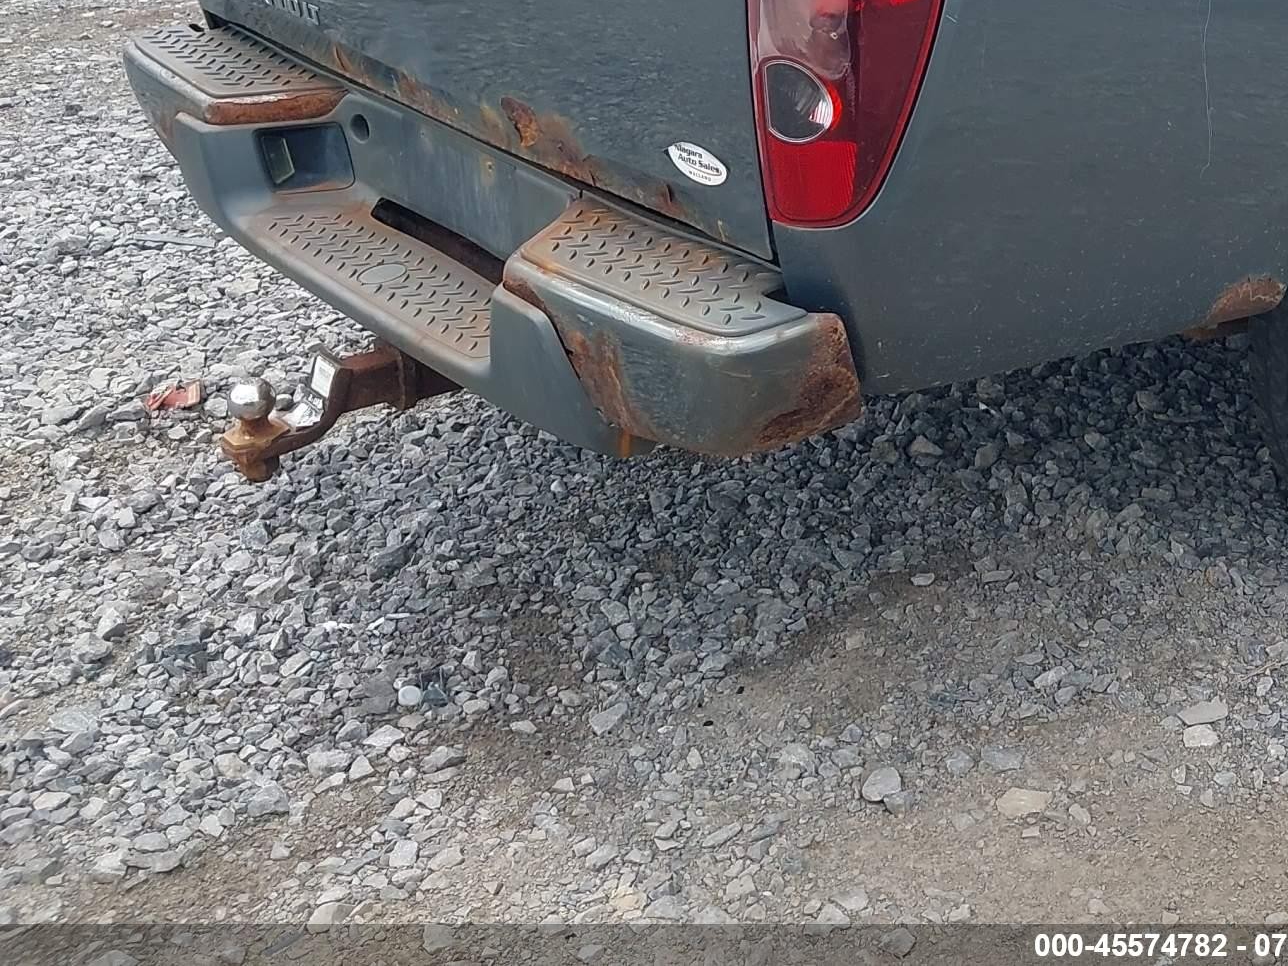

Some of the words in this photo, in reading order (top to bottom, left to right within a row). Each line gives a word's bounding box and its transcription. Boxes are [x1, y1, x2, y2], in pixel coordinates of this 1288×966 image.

[301, 0, 321, 26] LT
[674, 144, 703, 159] Niagara
[678, 153, 697, 166] Auto
[698, 159, 720, 173] Sales
